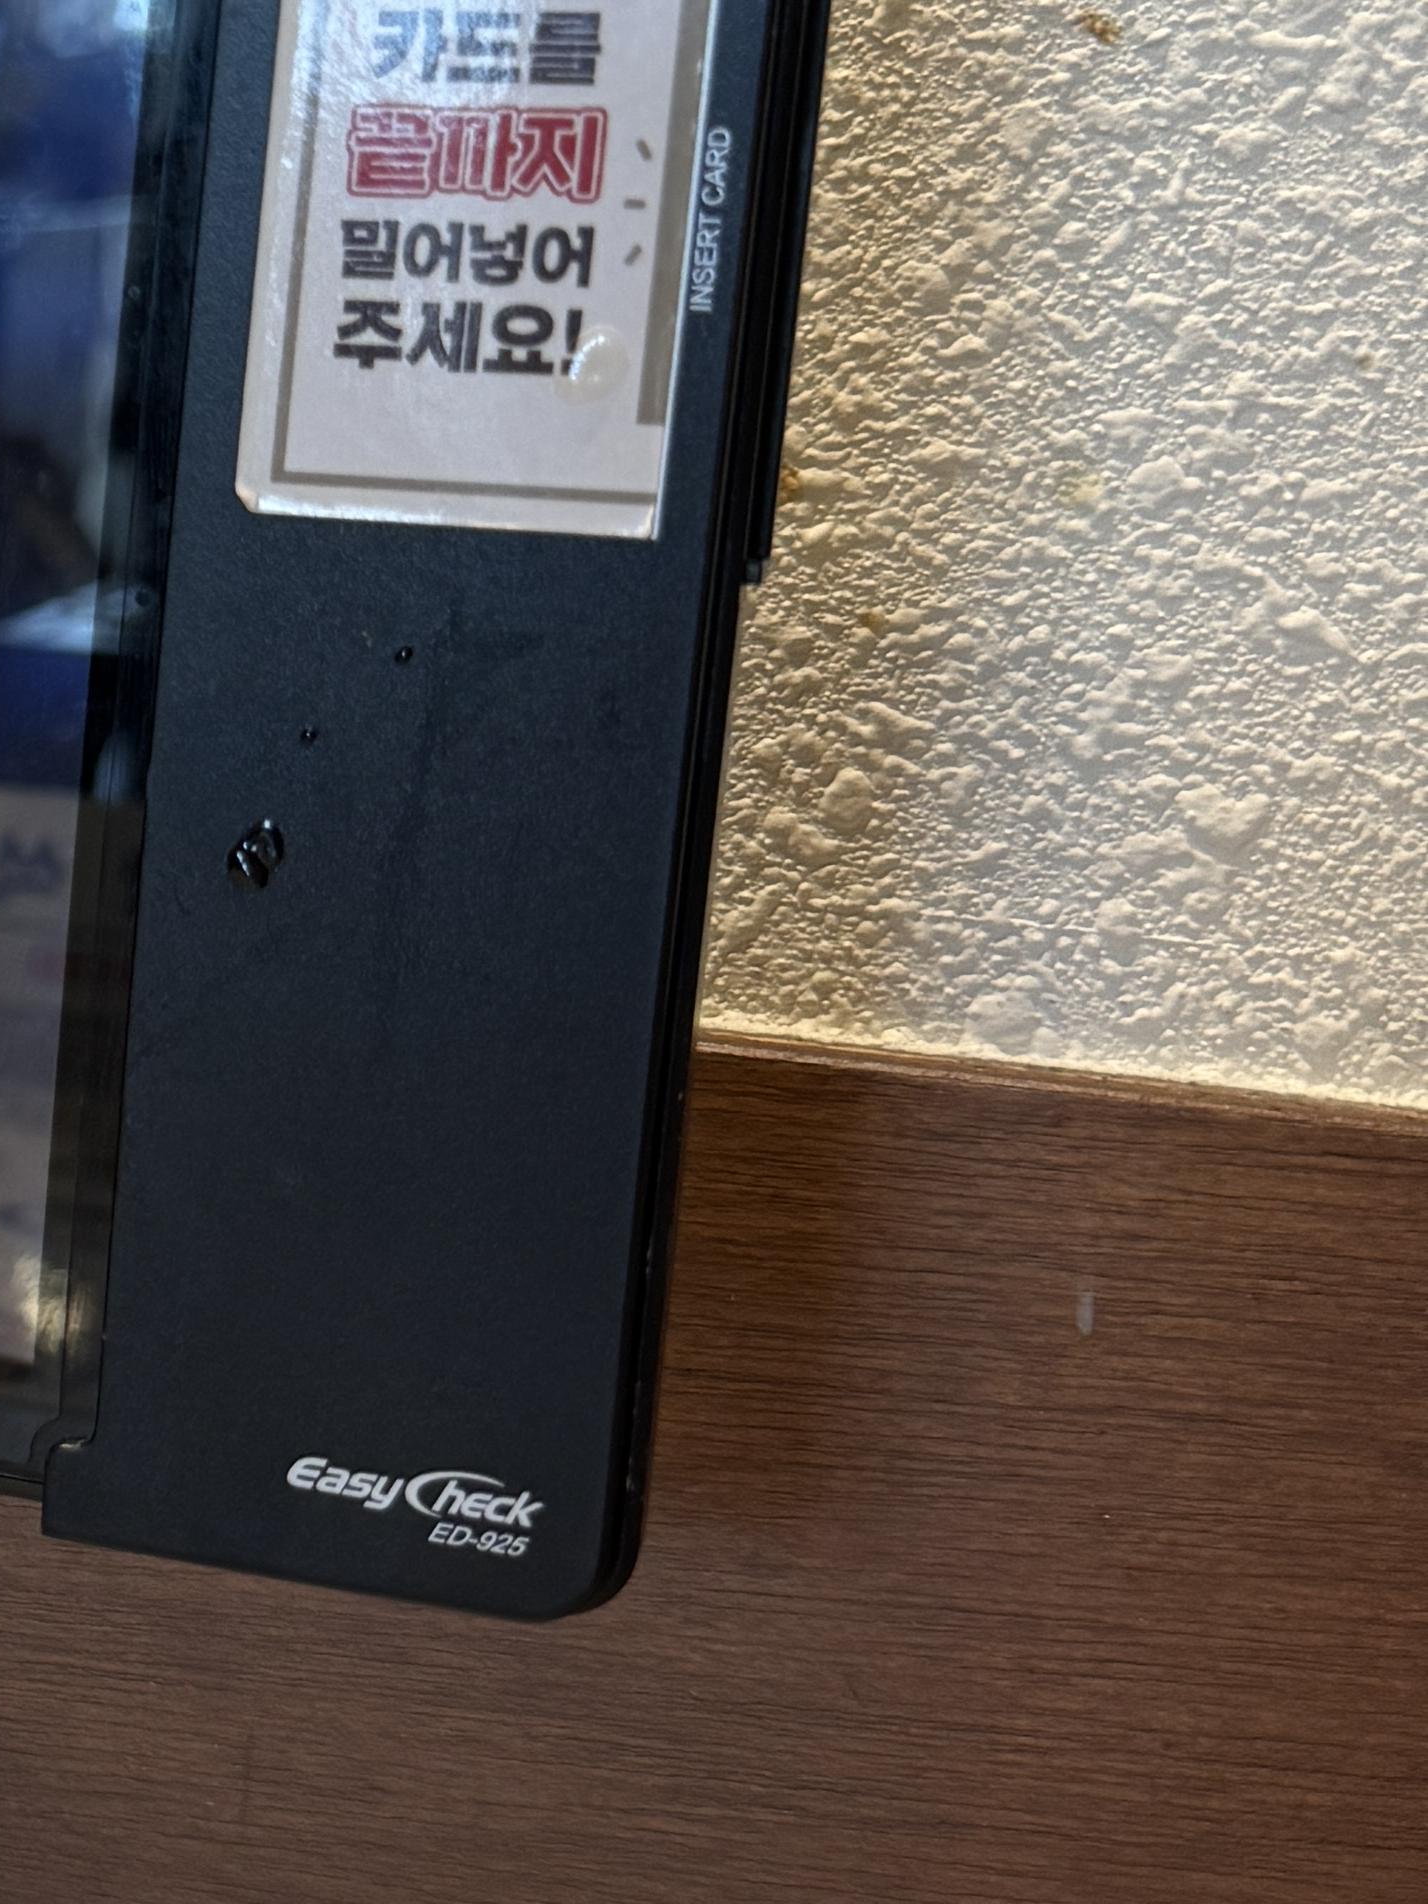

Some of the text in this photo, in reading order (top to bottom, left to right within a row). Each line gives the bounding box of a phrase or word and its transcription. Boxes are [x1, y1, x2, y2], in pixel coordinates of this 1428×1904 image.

[369, 7, 602, 87] 카드를
[346, 103, 608, 203] 끝까지
[340, 217, 595, 288] 밀어넣어
[689, 127, 731, 313] INSERT CARD
[332, 300, 583, 376] 주세요!
[427, 1522, 530, 1557] ED-925
